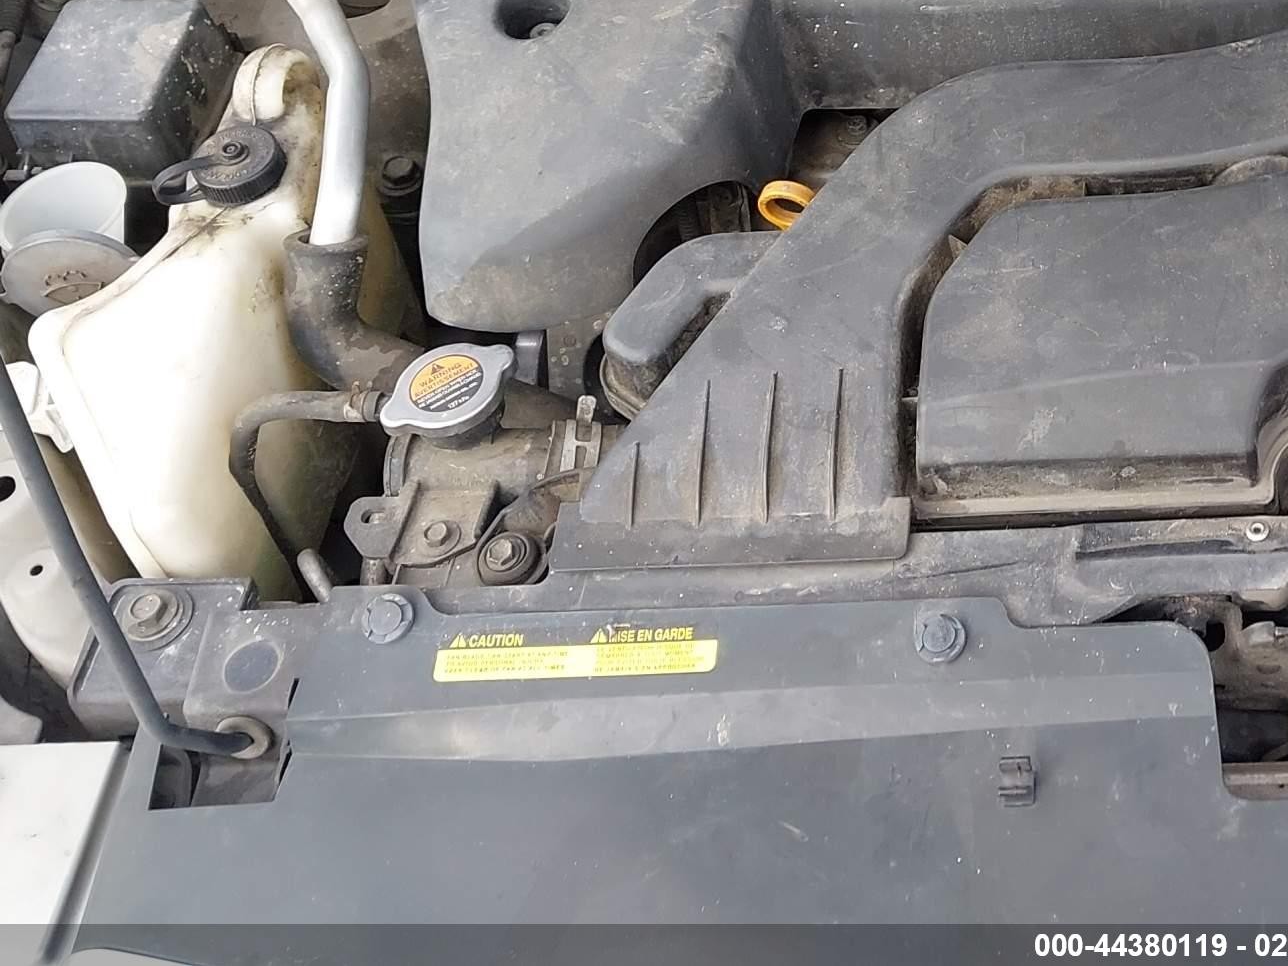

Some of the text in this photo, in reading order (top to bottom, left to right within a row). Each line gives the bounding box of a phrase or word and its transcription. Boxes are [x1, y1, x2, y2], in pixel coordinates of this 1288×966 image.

[419, 362, 462, 387] WARNING
[468, 633, 524, 648] CAUTION
[636, 628, 653, 641] EN
[654, 627, 694, 641] GARDE
